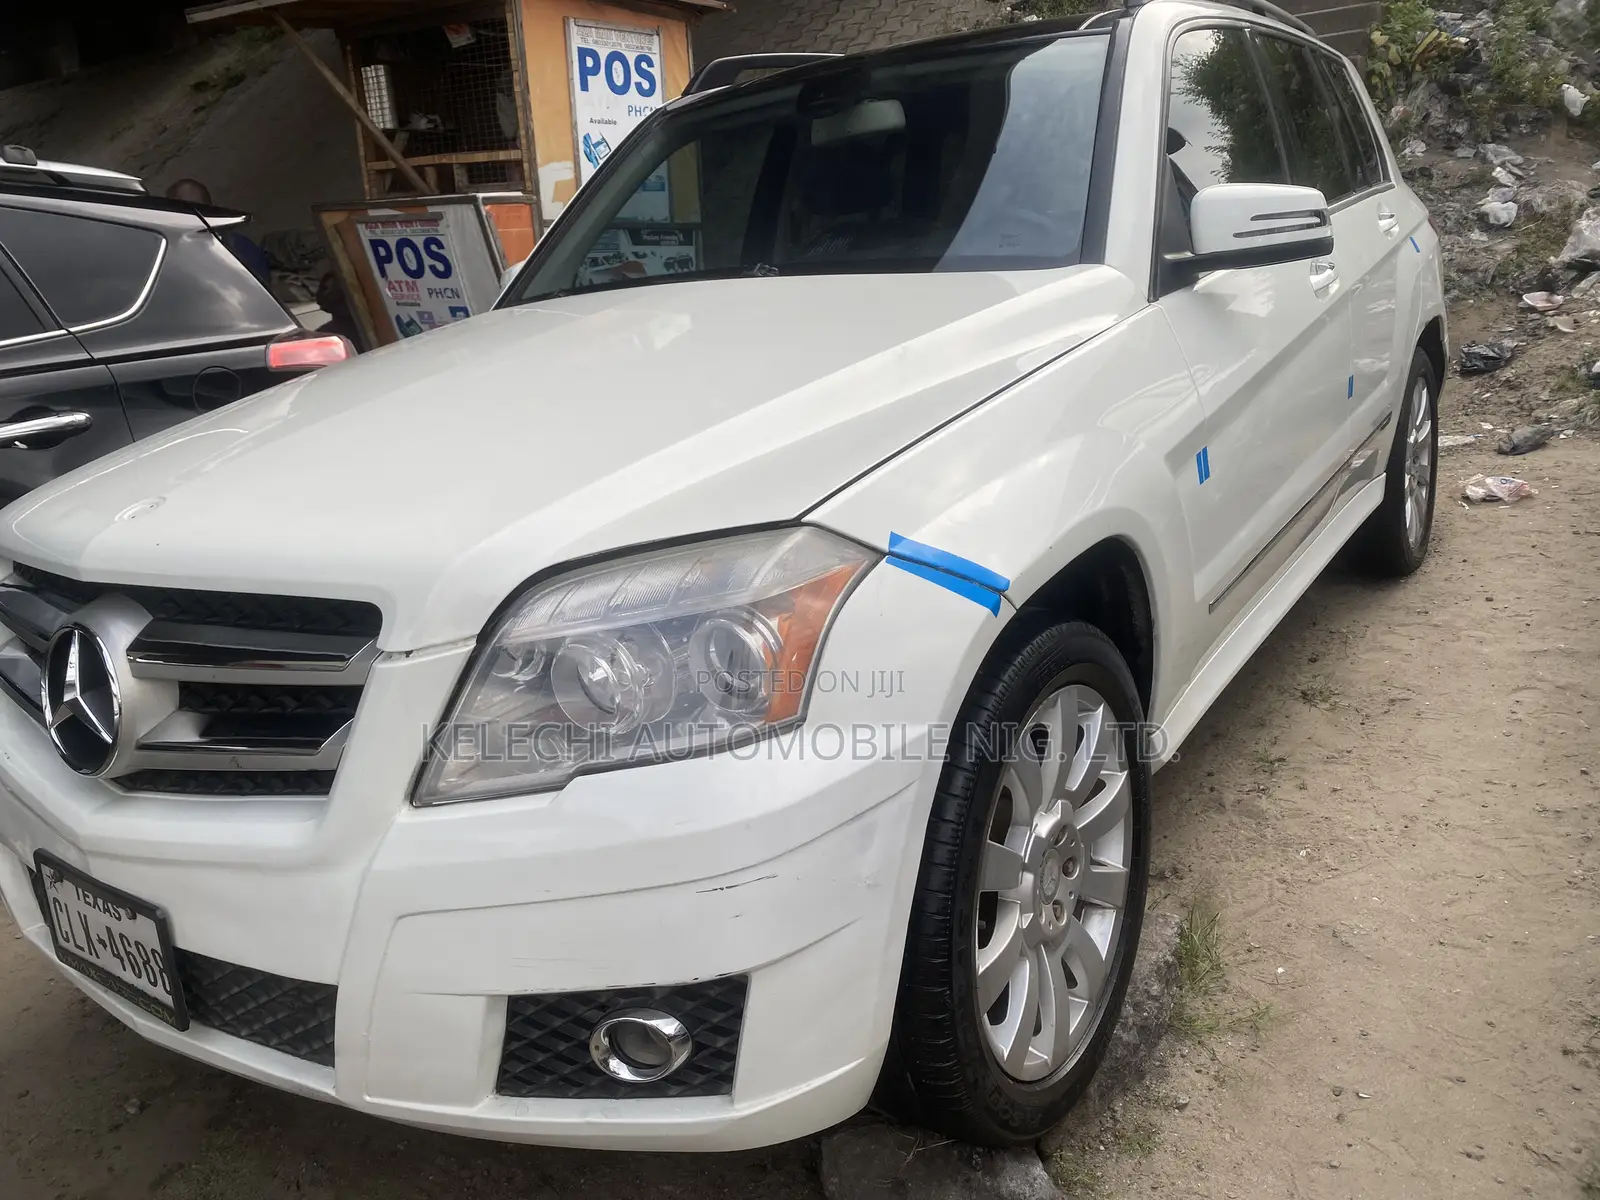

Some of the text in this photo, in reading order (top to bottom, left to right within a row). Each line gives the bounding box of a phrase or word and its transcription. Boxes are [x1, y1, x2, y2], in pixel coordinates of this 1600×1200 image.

[577, 46, 657, 97] POS
[589, 117, 617, 126] Available
[368, 236, 453, 280] POS
[387, 280, 420, 293] ATM
[427, 287, 460, 300] PHCN
[75, 886, 122, 922] TEXAS
